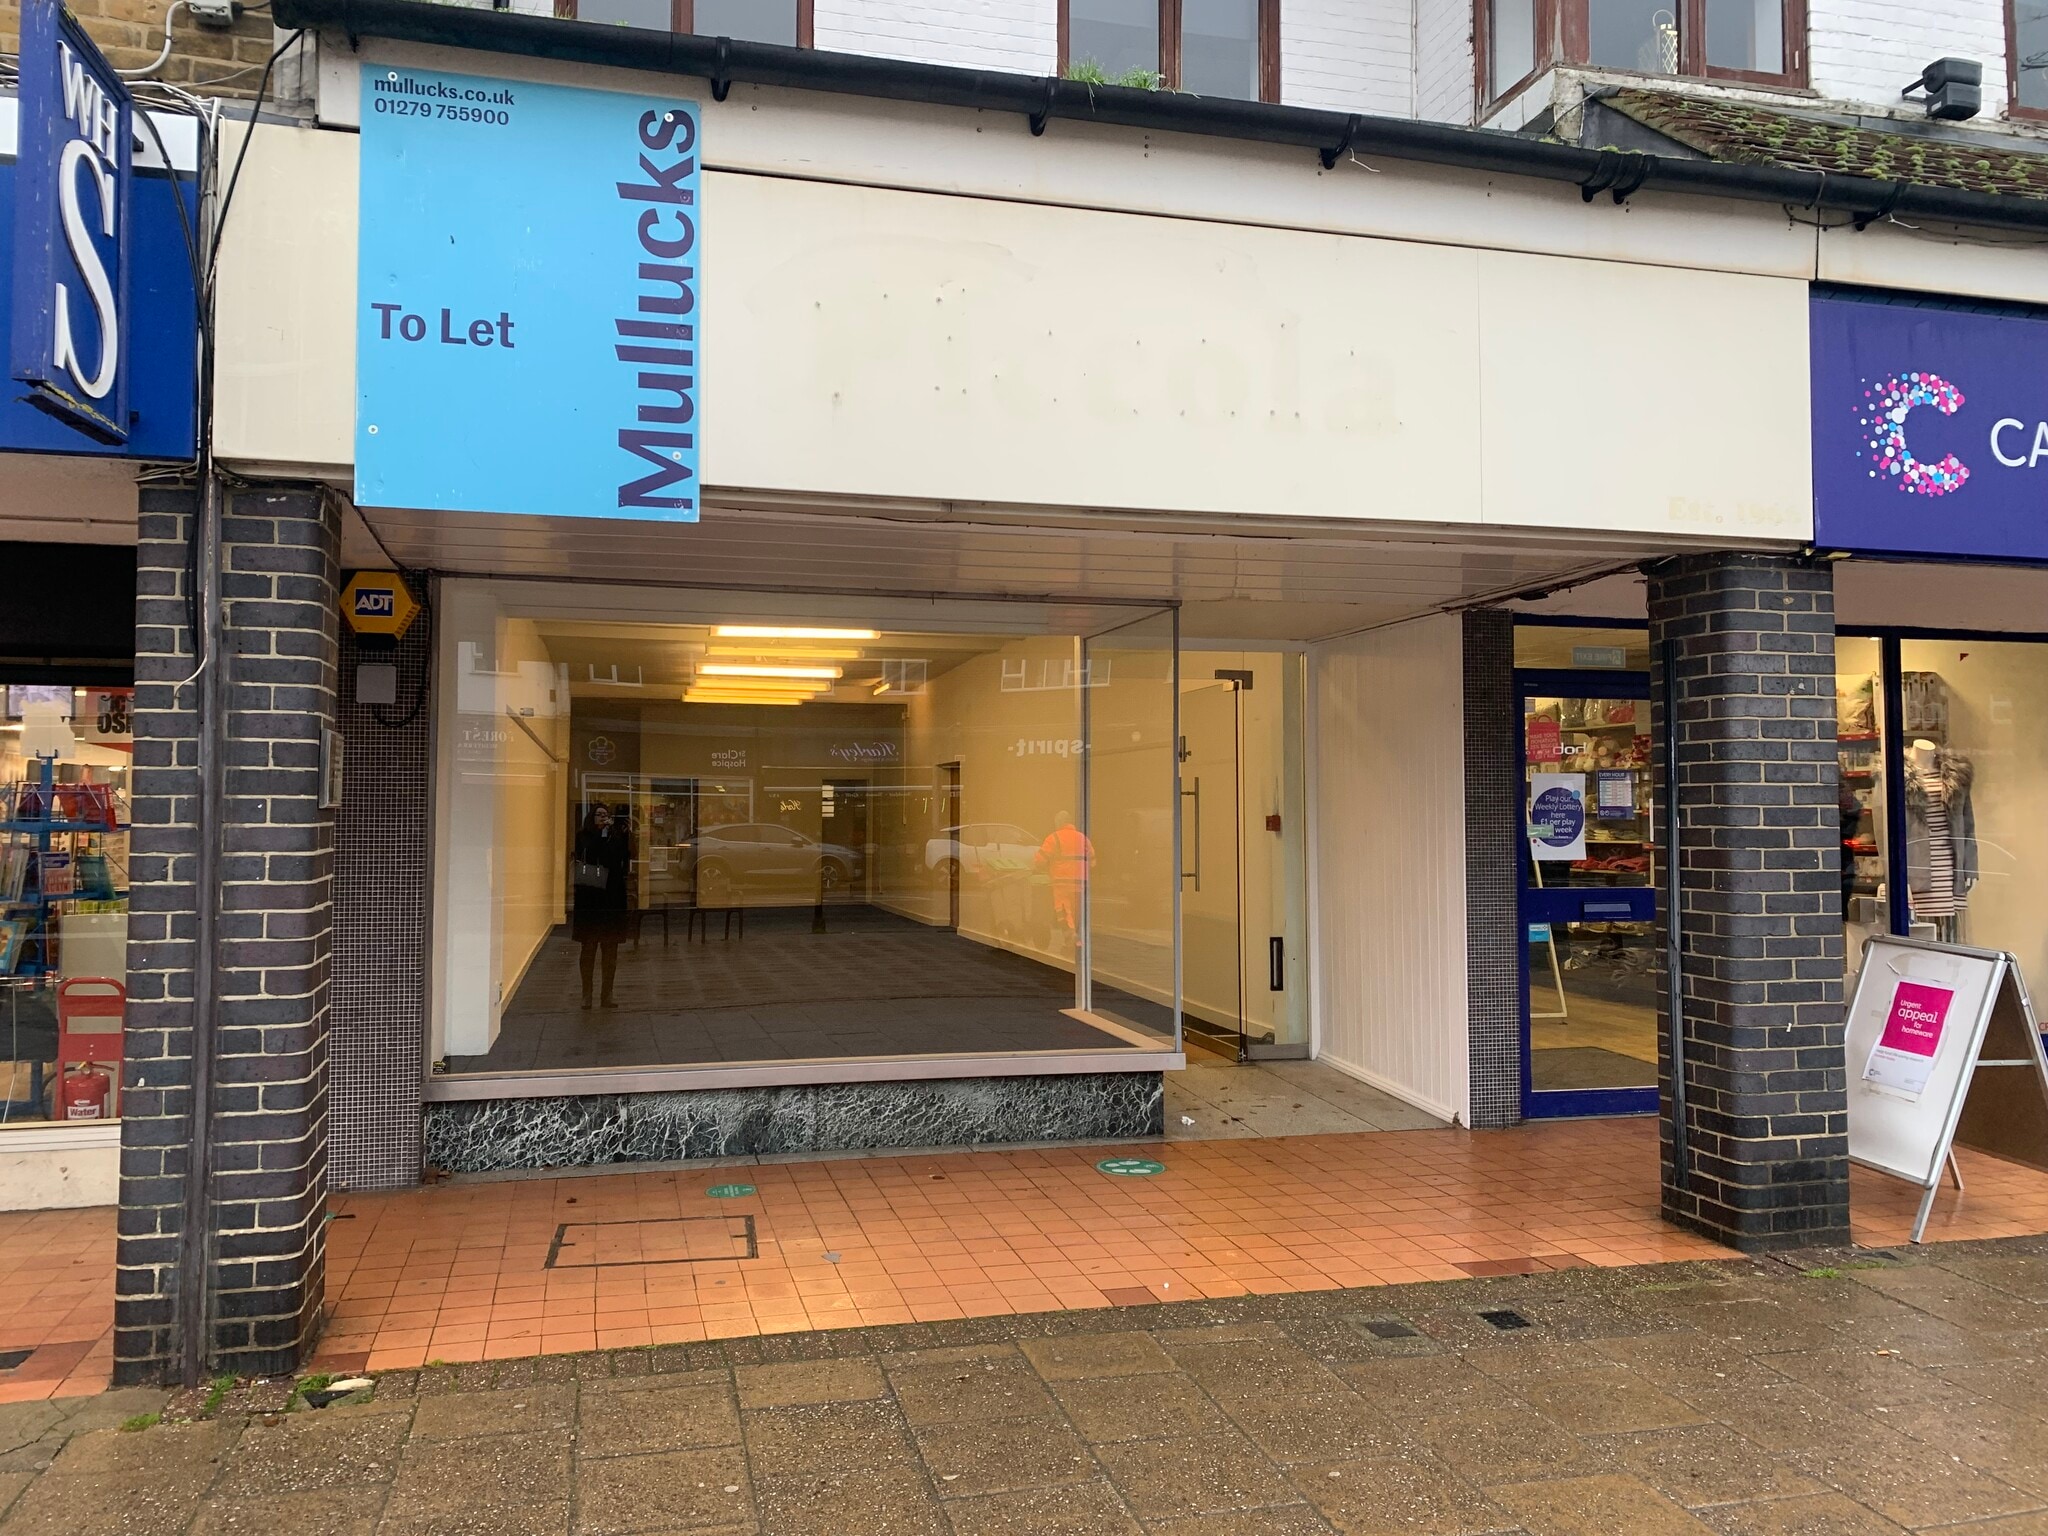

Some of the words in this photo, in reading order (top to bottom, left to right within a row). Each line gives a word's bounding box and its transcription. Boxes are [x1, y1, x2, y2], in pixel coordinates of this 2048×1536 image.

[374, 78, 515, 105] mullucks.co.uk
[374, 98, 432, 117] 01279
[436, 104, 509, 125] 755900
[614, 107, 696, 509] Mullucks
[371, 302, 427, 342] To
[439, 308, 516, 349] Let
[355, 594, 393, 611] ADT
[1545, 795, 1558, 803] Play
[1535, 803, 1558, 811] Weekly
[1560, 803, 1581, 811] Lottery
[1900, 1000, 1921, 1010] Urgent
[1898, 1007, 1938, 1023] appeal
[1901, 1025, 1934, 1038] homeware
[1914, 1021, 1923, 1029] for
[70, 1108, 97, 1116] Water
